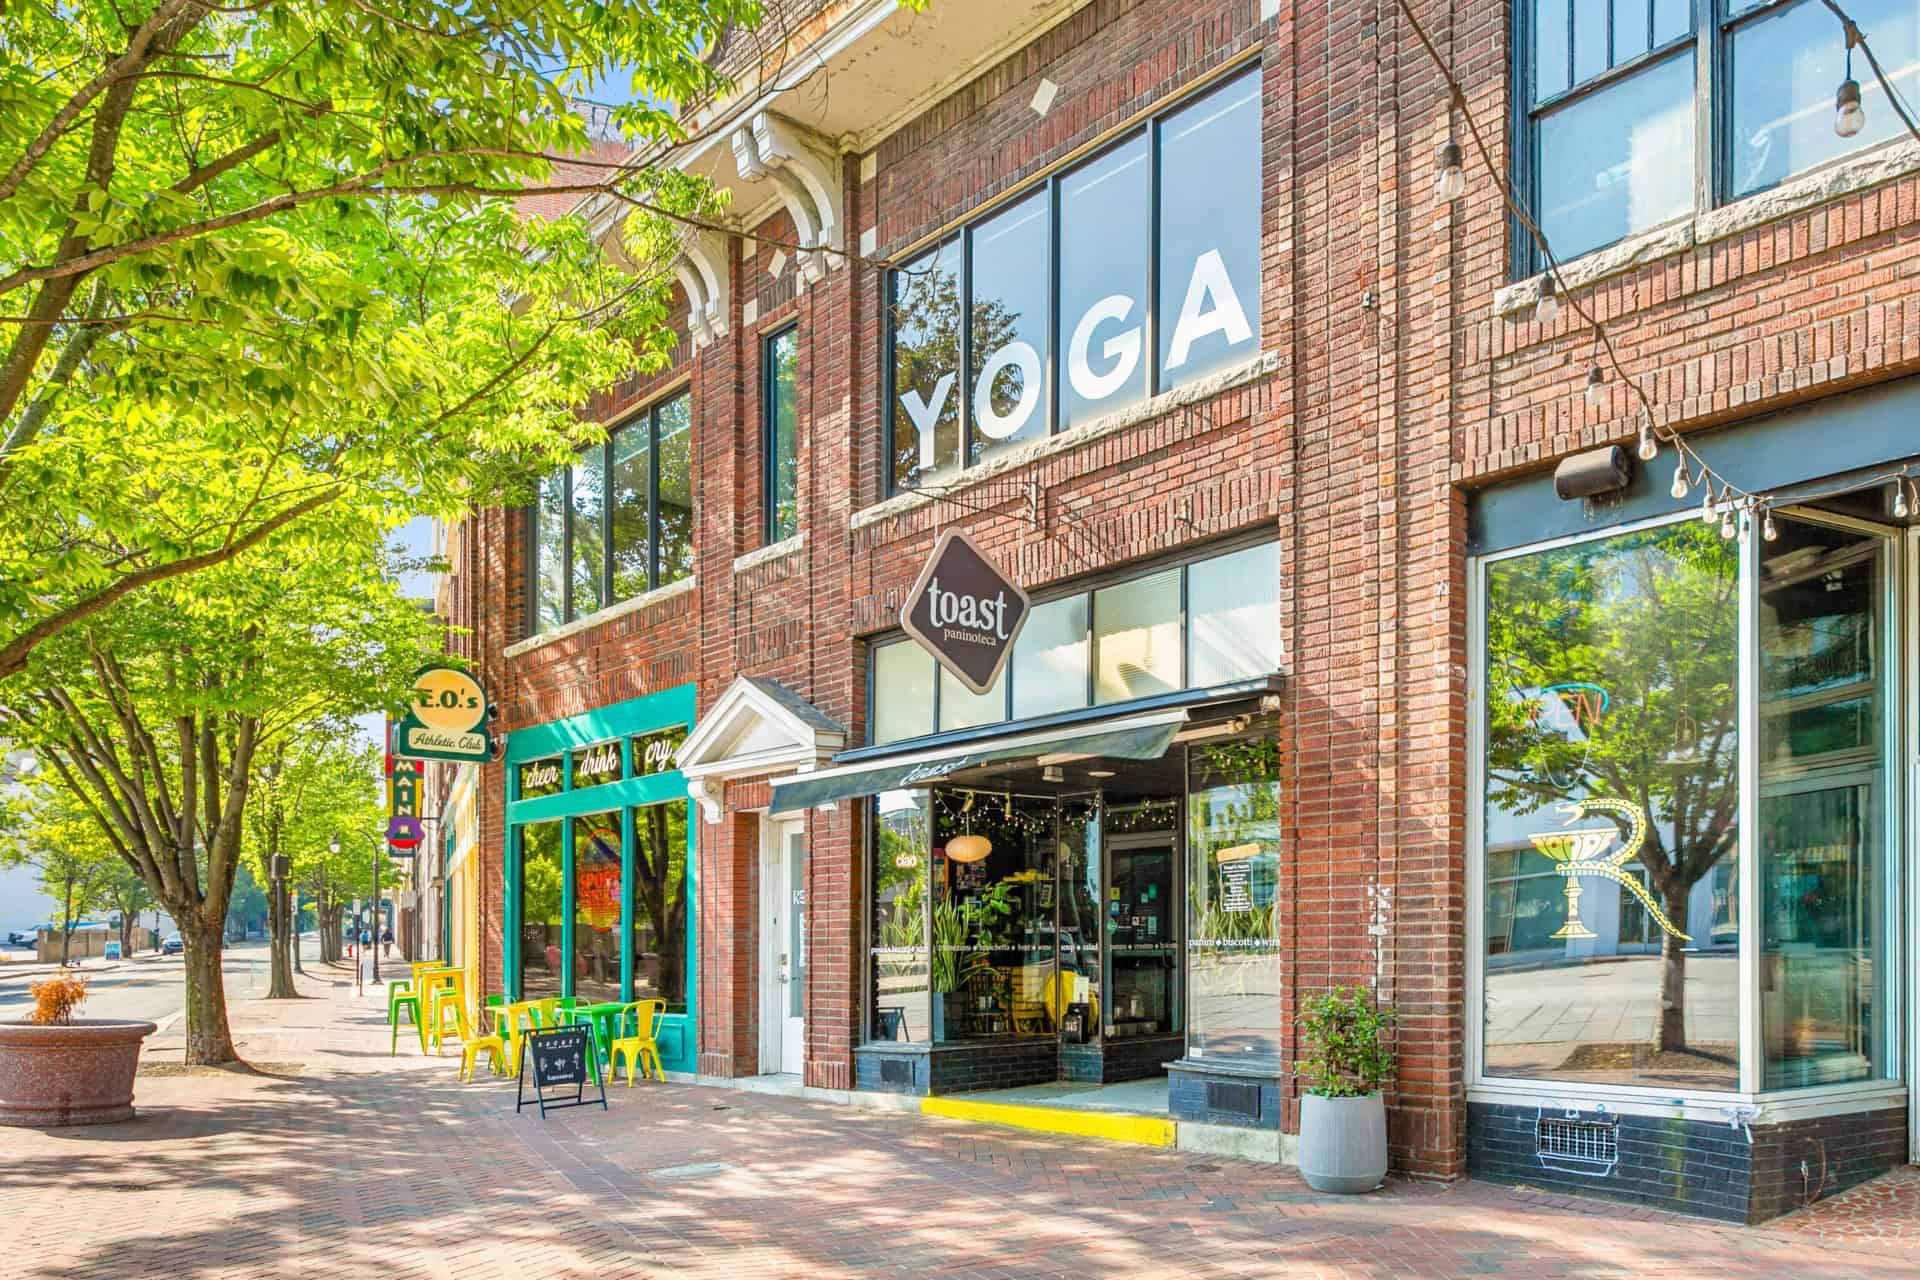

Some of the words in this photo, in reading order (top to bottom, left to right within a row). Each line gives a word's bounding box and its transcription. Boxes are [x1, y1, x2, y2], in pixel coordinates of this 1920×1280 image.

[899, 247, 1254, 471] YOGA
[927, 576, 1009, 641] toast
[943, 627, 997, 647] paninoteca
[414, 733, 455, 747] Athletic
[458, 736, 482, 750] Club
[526, 761, 559, 788] cheer
[580, 745, 618, 777] drink
[644, 739, 673, 772] cry
